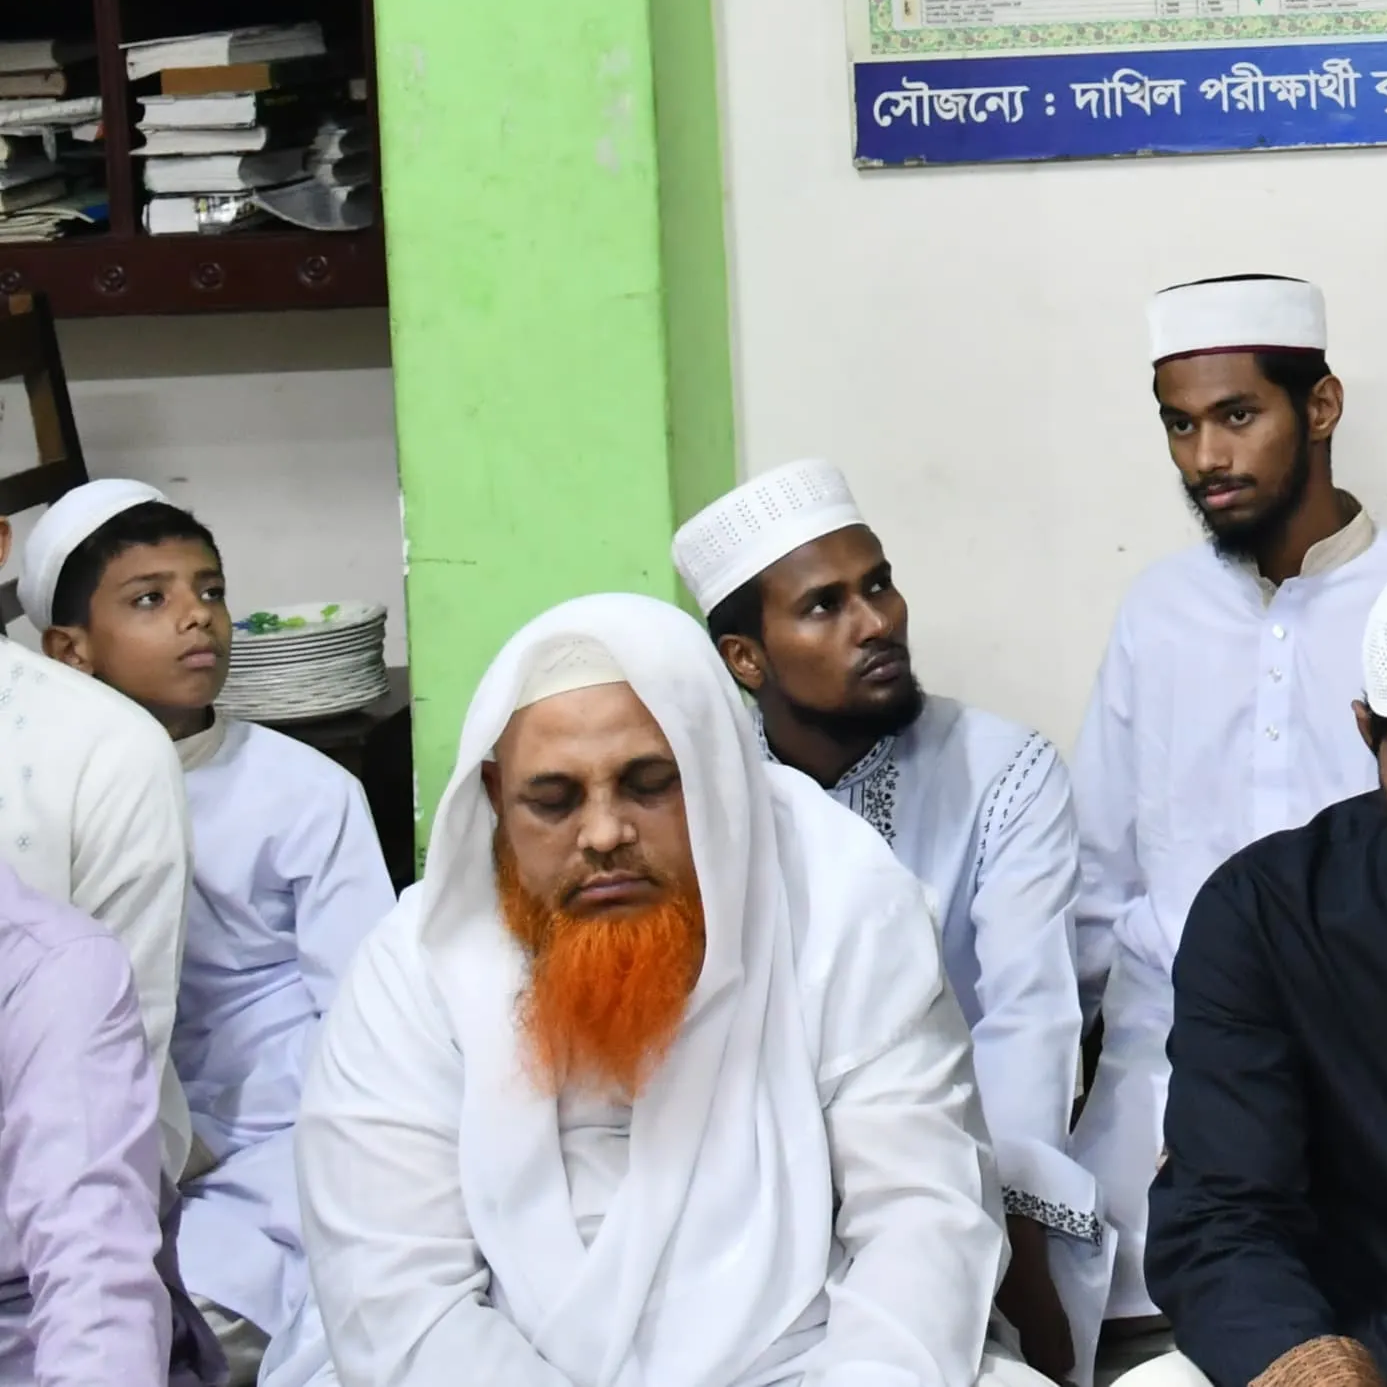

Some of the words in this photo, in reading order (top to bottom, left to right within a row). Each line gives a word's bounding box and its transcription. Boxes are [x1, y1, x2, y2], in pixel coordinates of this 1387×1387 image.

[873, 76, 1028, 127] সৌজন্যে
[1070, 68, 1186, 120] দাখিল
[1198, 57, 1363, 114] পরীক্ষার্থী
